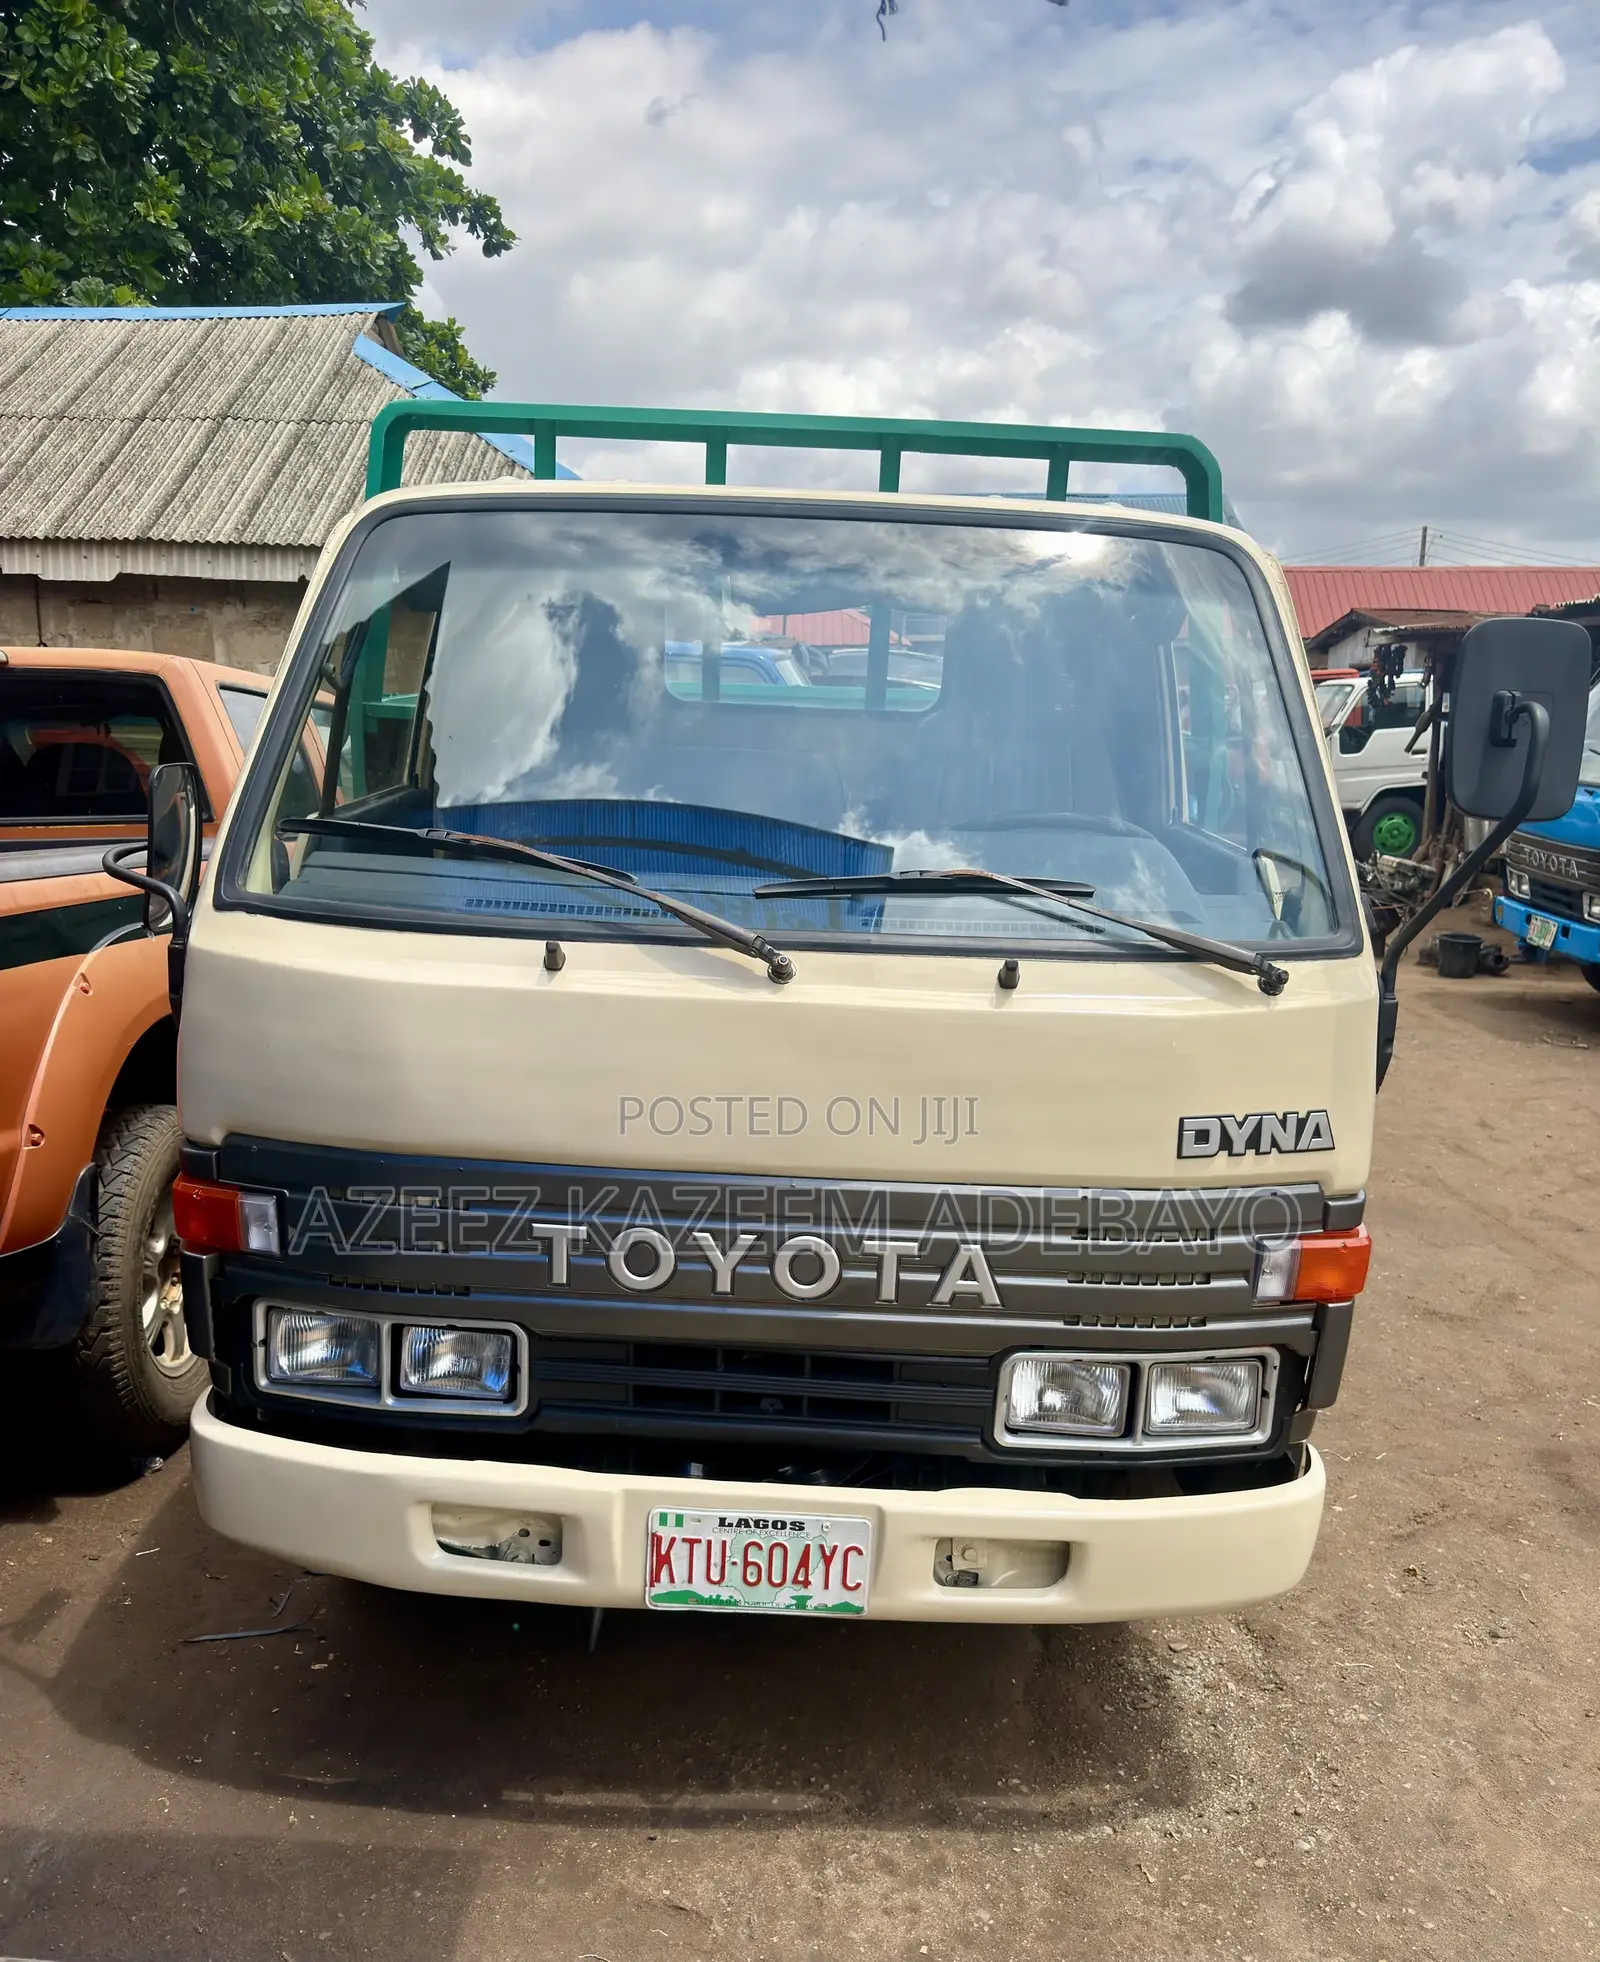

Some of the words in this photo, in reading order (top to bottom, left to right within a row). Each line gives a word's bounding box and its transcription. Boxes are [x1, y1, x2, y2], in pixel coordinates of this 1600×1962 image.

[1523, 848, 1579, 878] TOYOTA
[1177, 1109, 1335, 1159] DYNA
[531, 1222, 1004, 1307] TOYOTA
[711, 1526, 743, 1536] CENTRE
[745, 1528, 758, 1537] OF
[759, 1529, 811, 1539] EXCELLENCE
[717, 1516, 806, 1532] LAGOS
